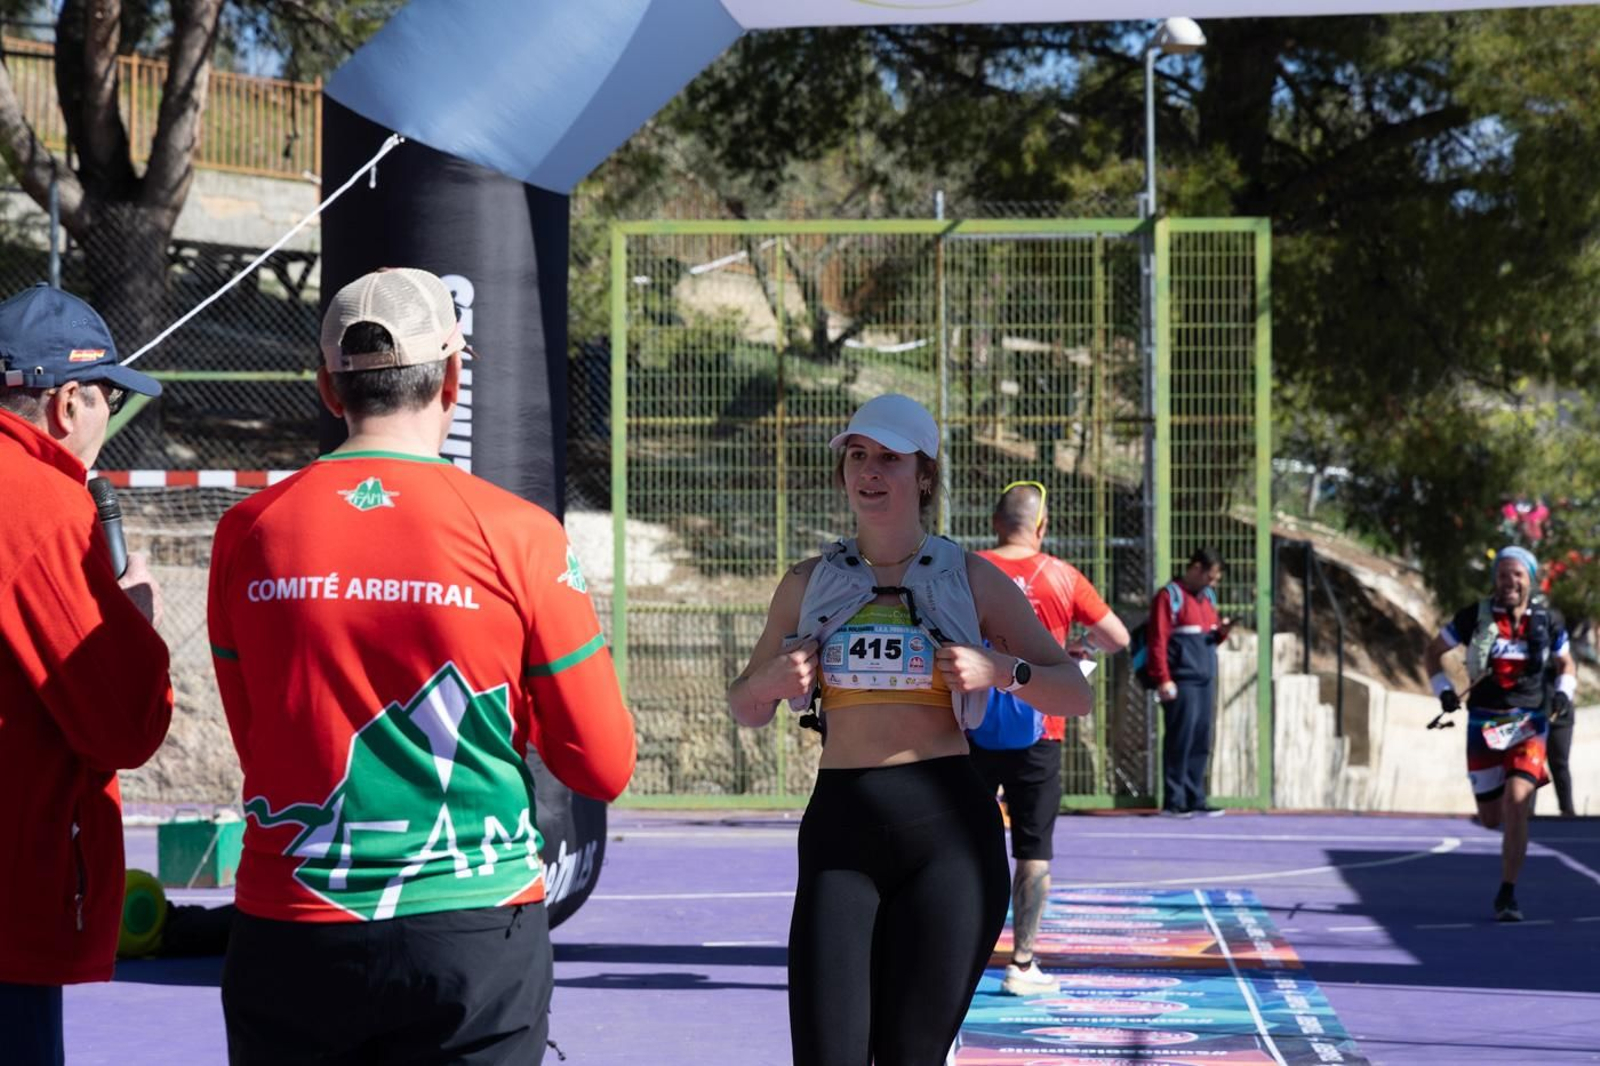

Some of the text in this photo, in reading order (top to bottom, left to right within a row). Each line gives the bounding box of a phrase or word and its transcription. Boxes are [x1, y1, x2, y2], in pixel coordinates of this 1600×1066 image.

[247, 573, 480, 609] COMITÉ ARBITRAL
[849, 637, 902, 660] 415
[327, 802, 541, 920] FAM
